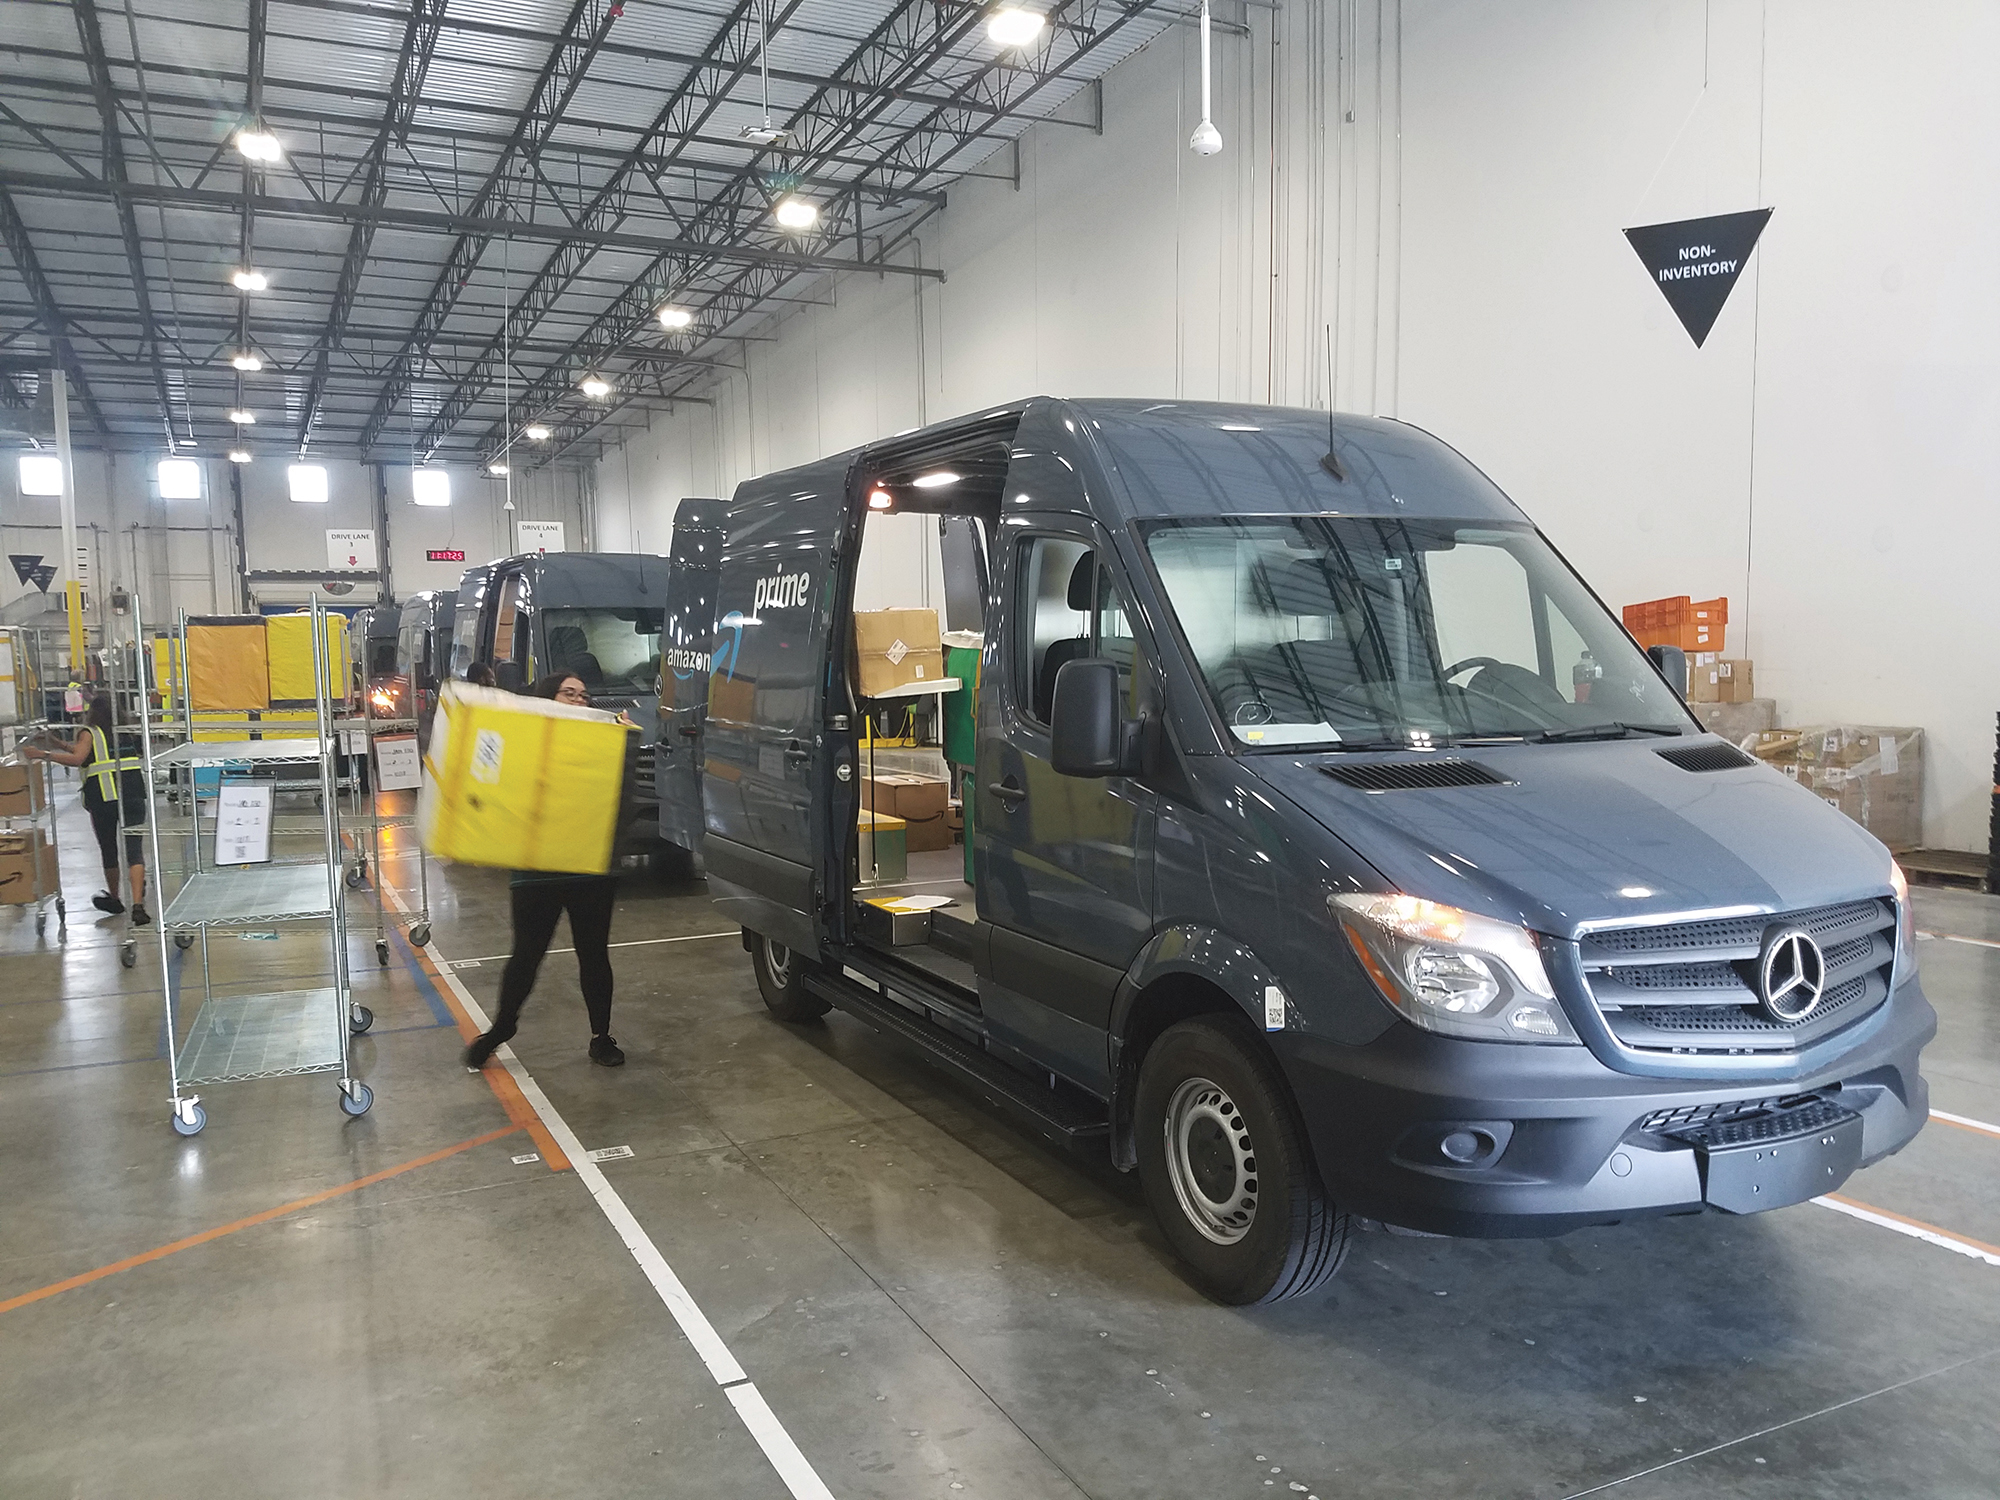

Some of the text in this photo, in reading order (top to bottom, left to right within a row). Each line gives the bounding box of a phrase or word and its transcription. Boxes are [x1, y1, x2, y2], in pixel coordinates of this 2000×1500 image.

[1679, 244, 1716, 260] NON-
[1659, 260, 1738, 282] INVENTORY
[752, 563, 810, 620] prime
[667, 648, 711, 672] amazon
